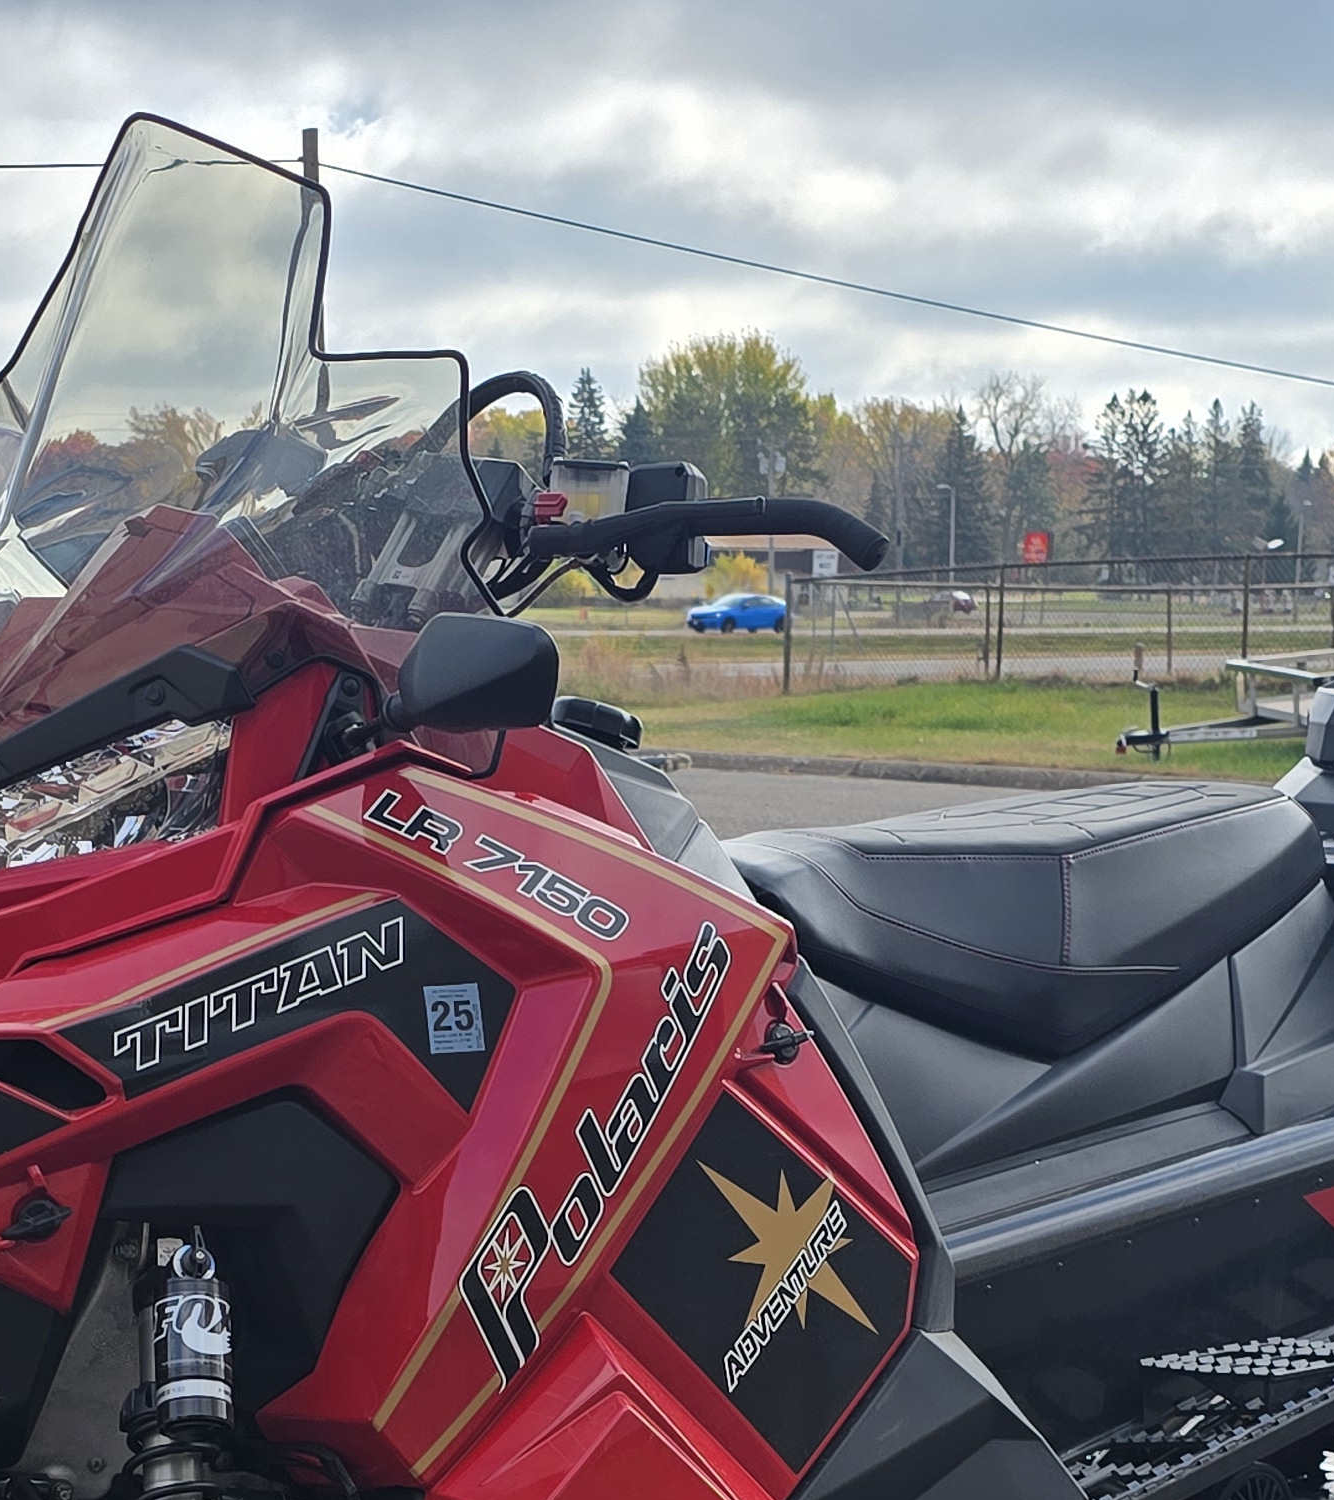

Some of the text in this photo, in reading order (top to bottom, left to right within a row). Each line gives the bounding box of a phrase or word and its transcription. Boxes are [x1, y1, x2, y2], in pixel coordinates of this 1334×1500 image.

[363, 788, 630, 941] LR 7150
[113, 916, 404, 1071] TITAN
[431, 999, 474, 1032] 25
[459, 921, 731, 1395] Polaris
[723, 1199, 848, 1394] ADVENTURE
